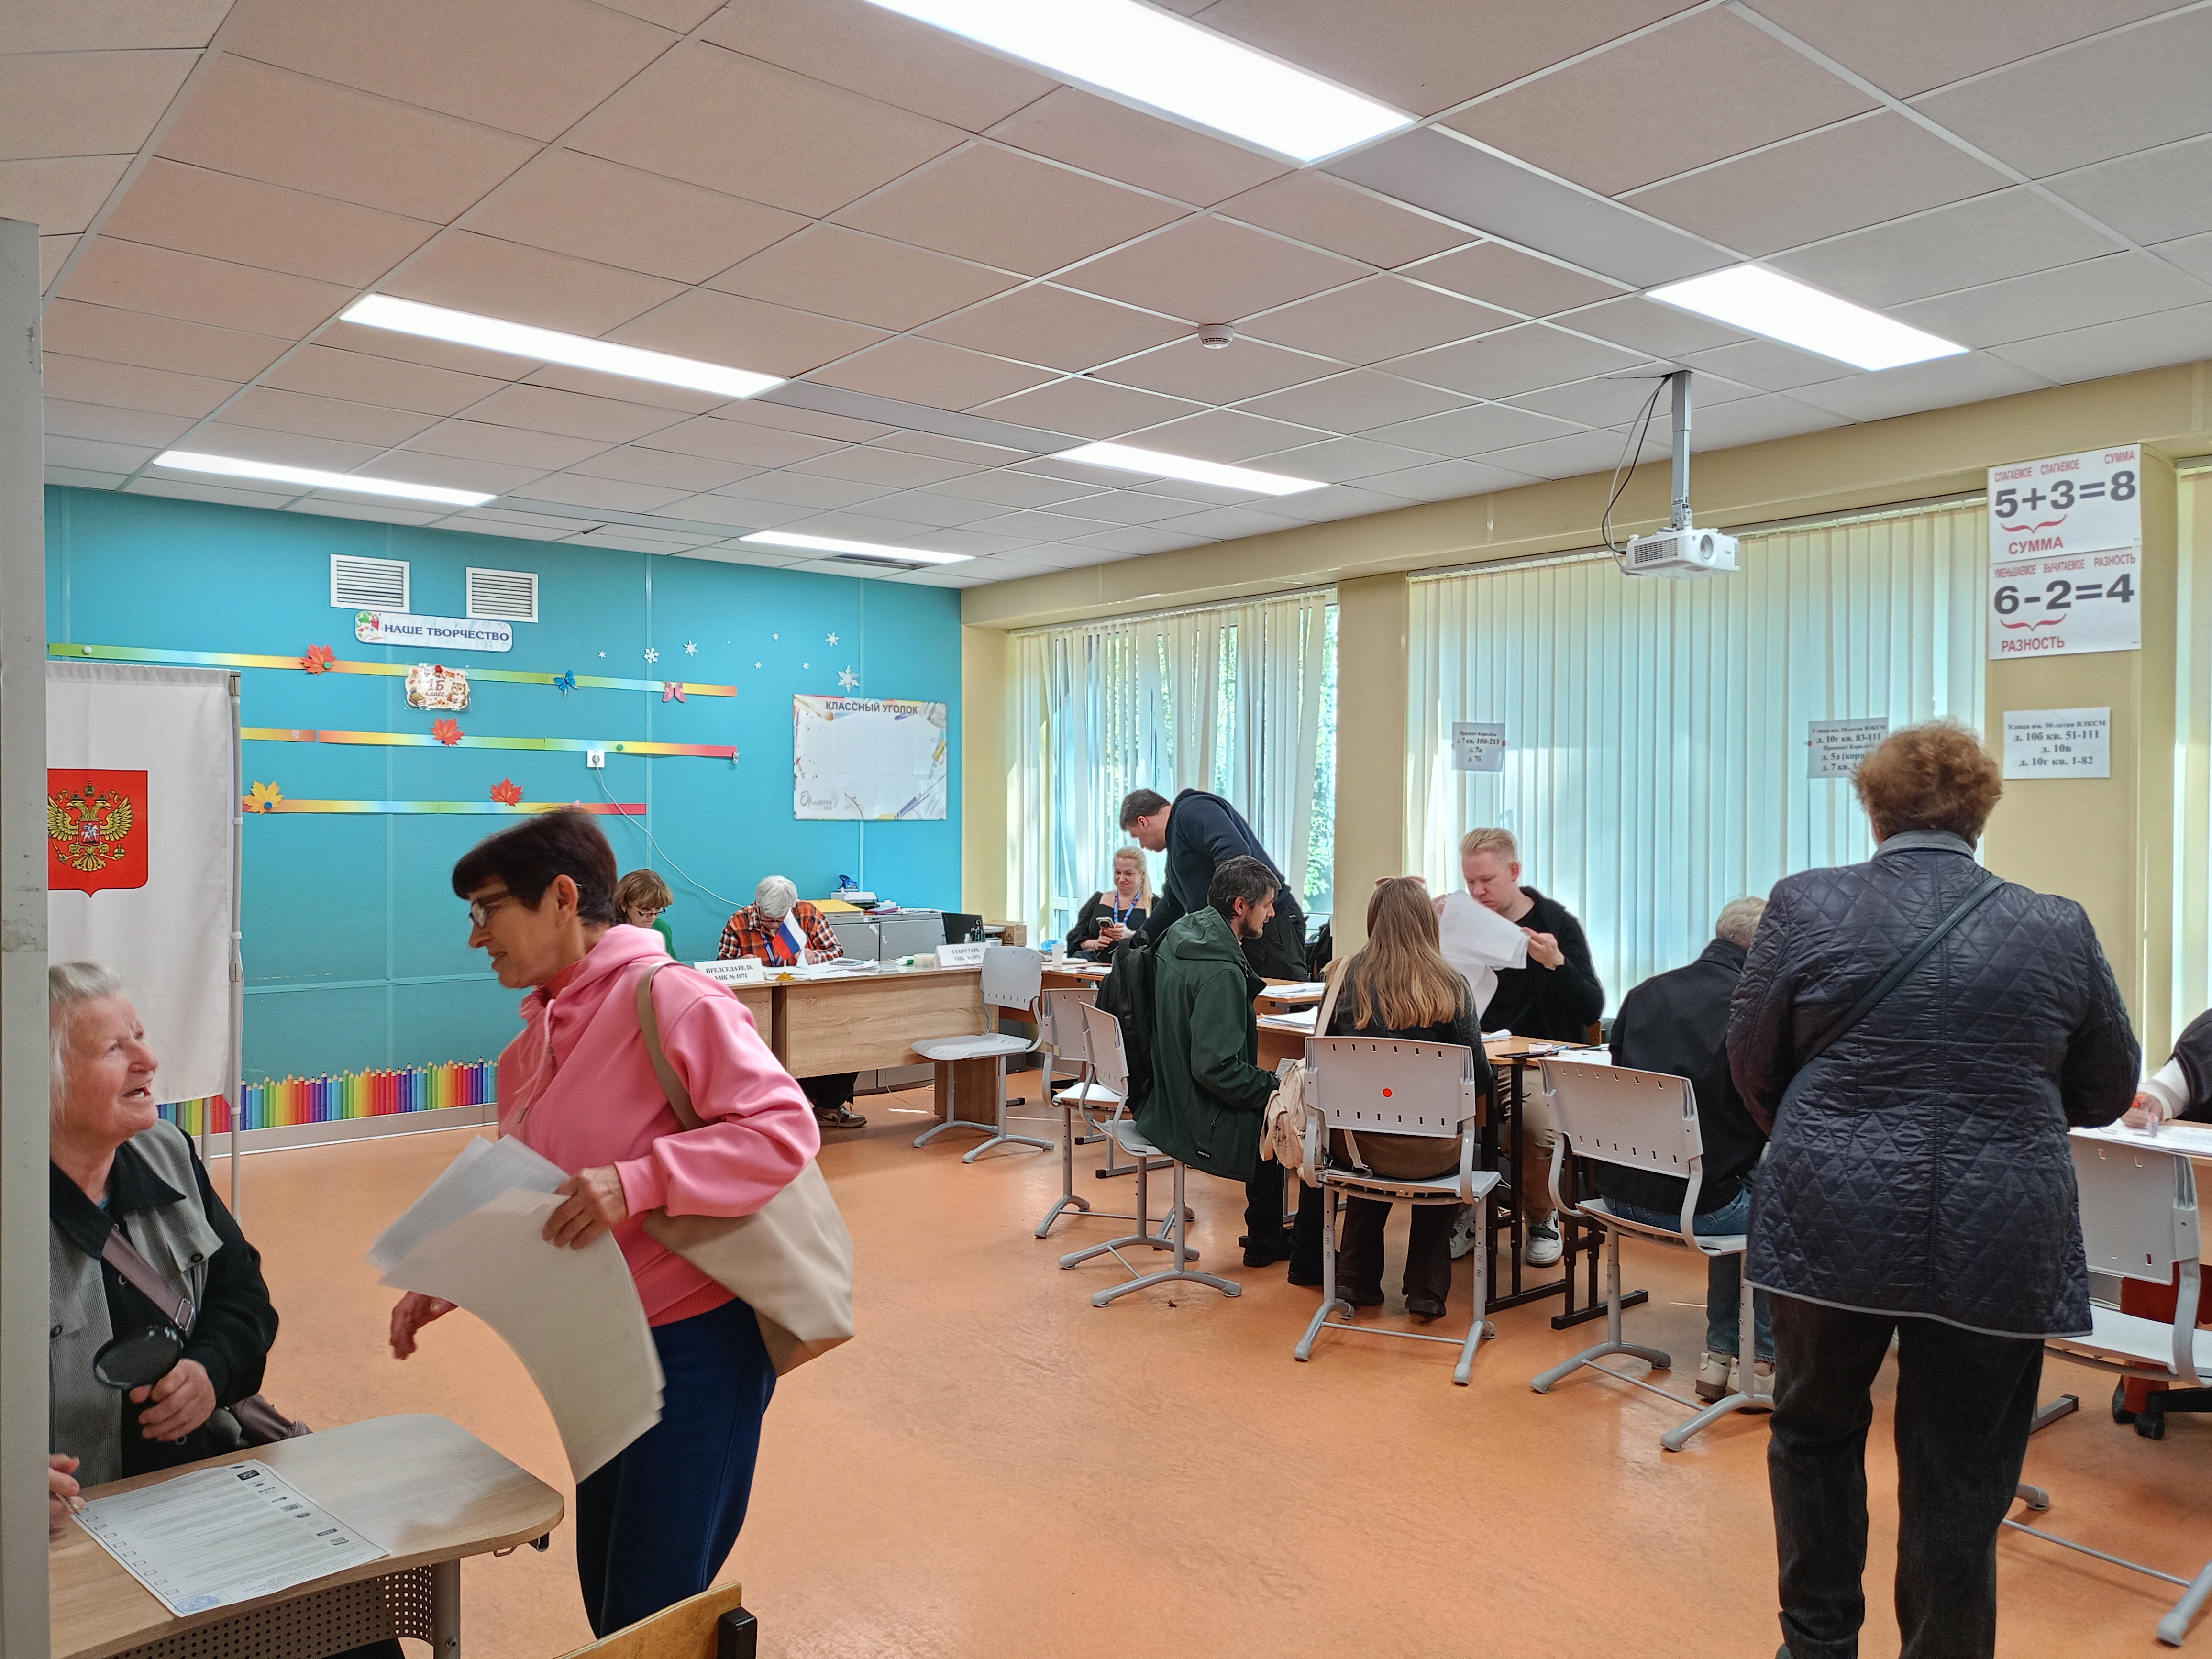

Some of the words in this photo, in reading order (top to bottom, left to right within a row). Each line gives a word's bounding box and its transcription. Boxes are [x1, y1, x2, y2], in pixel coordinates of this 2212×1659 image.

[1994, 467, 2032, 482] СЛАГАЕМОЕ
[2040, 459, 2079, 475] СЛАГАЕМОЕ
[2105, 450, 2135, 465] СУММА
[2009, 536, 2064, 554] СУММА
[1994, 564, 2036, 579] УМЕНЬШАЕМОЕ
[2043, 559, 2085, 573] ВЫЧИТАЕМОЕ
[2094, 554, 2135, 567] РАЗНОСТЬ
[384, 624, 423, 635] НАШЕ
[426, 628, 509, 641] ТВОРЧЕСТВО
[2002, 636, 2065, 652] РАЗНОСТЬ
[826, 701, 880, 712] КЛАССНЫЙ
[883, 704, 918, 714] УГОЛОК
[1856, 733, 1880, 741] 83-111
[2065, 730, 2099, 740] 51-111
[2054, 744, 2072, 752] 10в
[2072, 756, 2093, 765] 1-82
[706, 965, 753, 973] ПРЕДСЕДАТЕЛЬ
